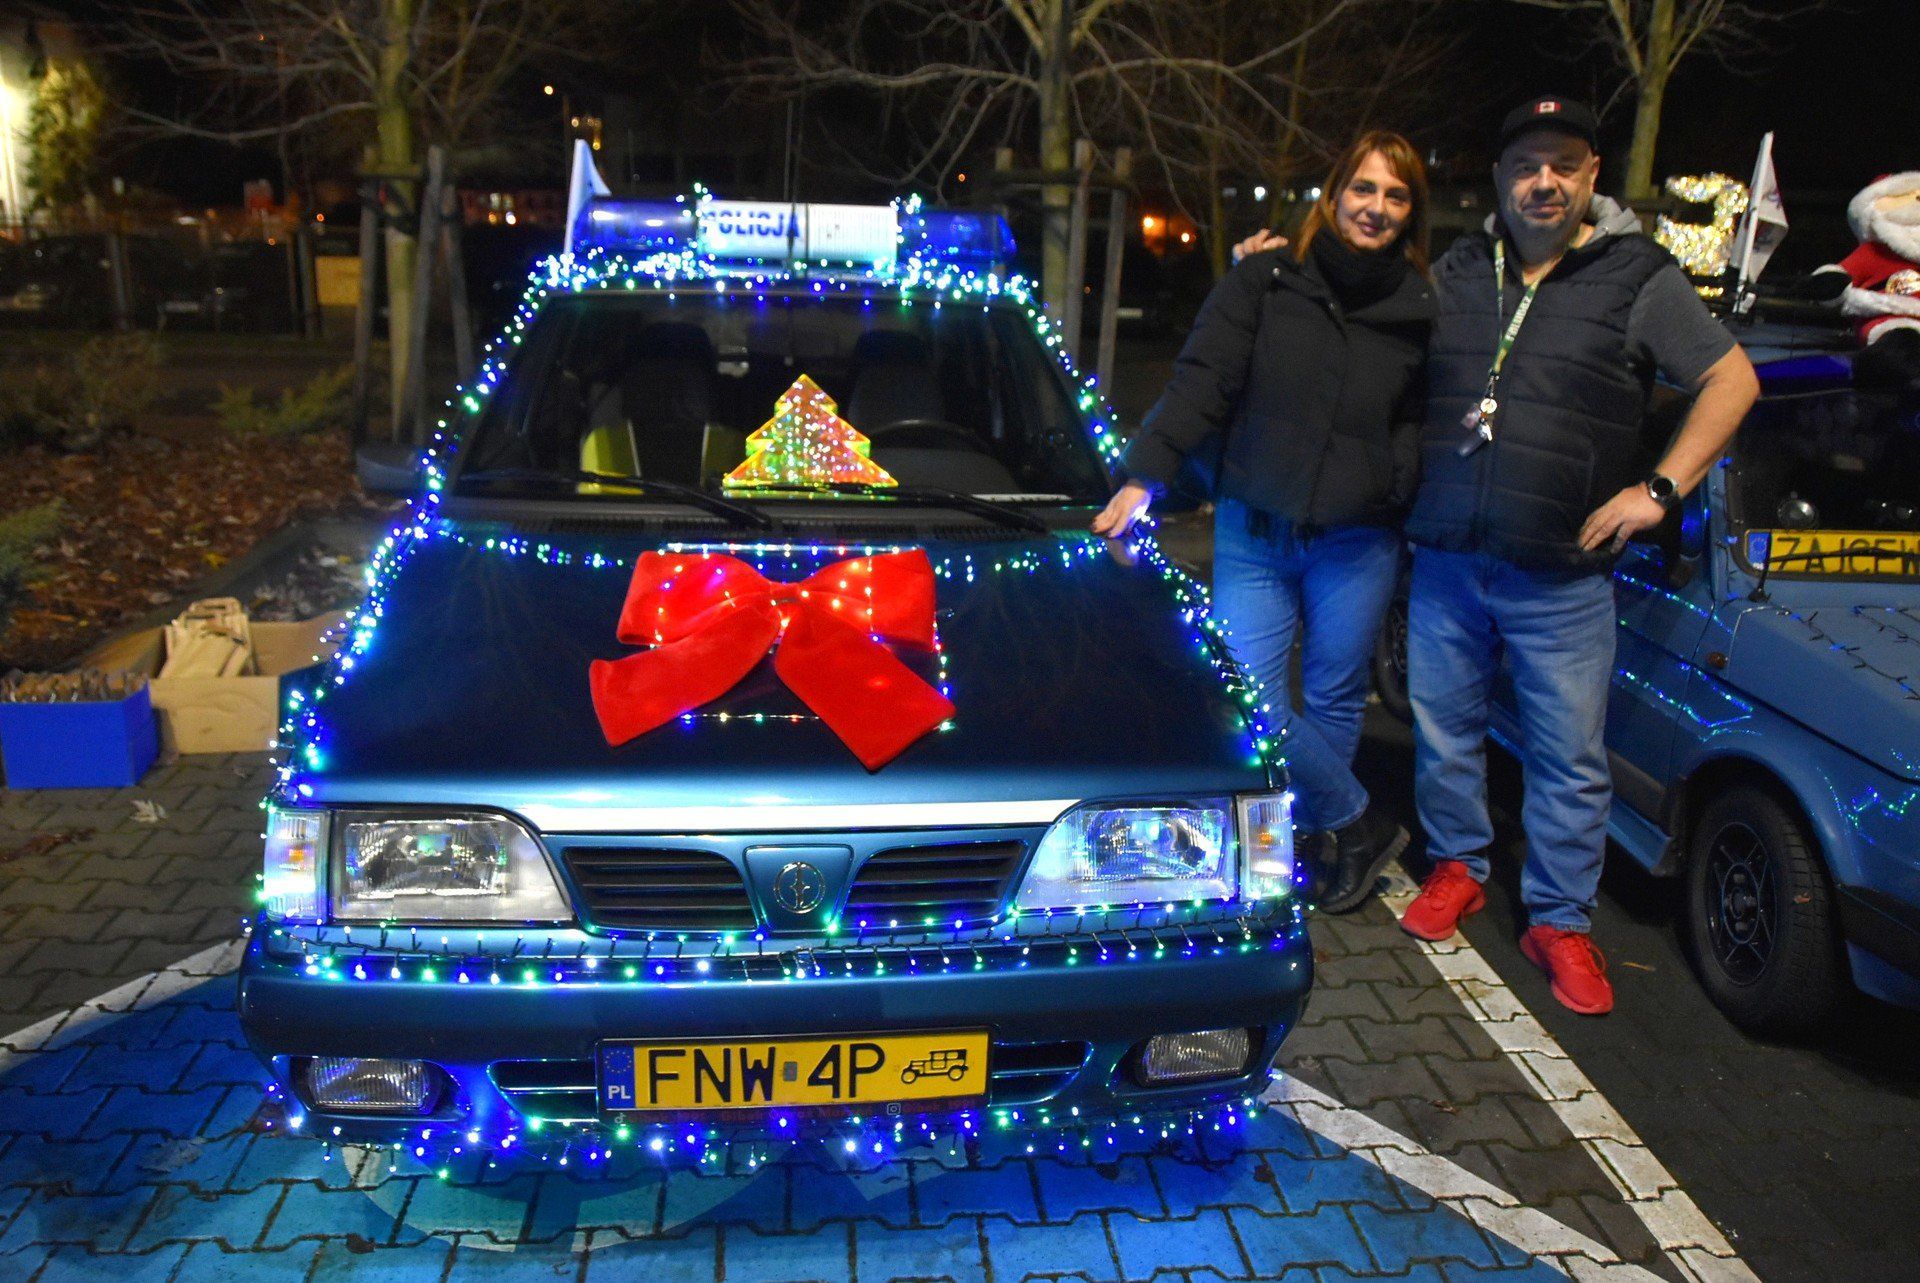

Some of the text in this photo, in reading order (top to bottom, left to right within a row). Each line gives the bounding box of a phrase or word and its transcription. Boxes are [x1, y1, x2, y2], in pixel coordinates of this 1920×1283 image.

[607, 1084, 631, 1100] PL
[648, 1043, 886, 1104] FNW 4P
